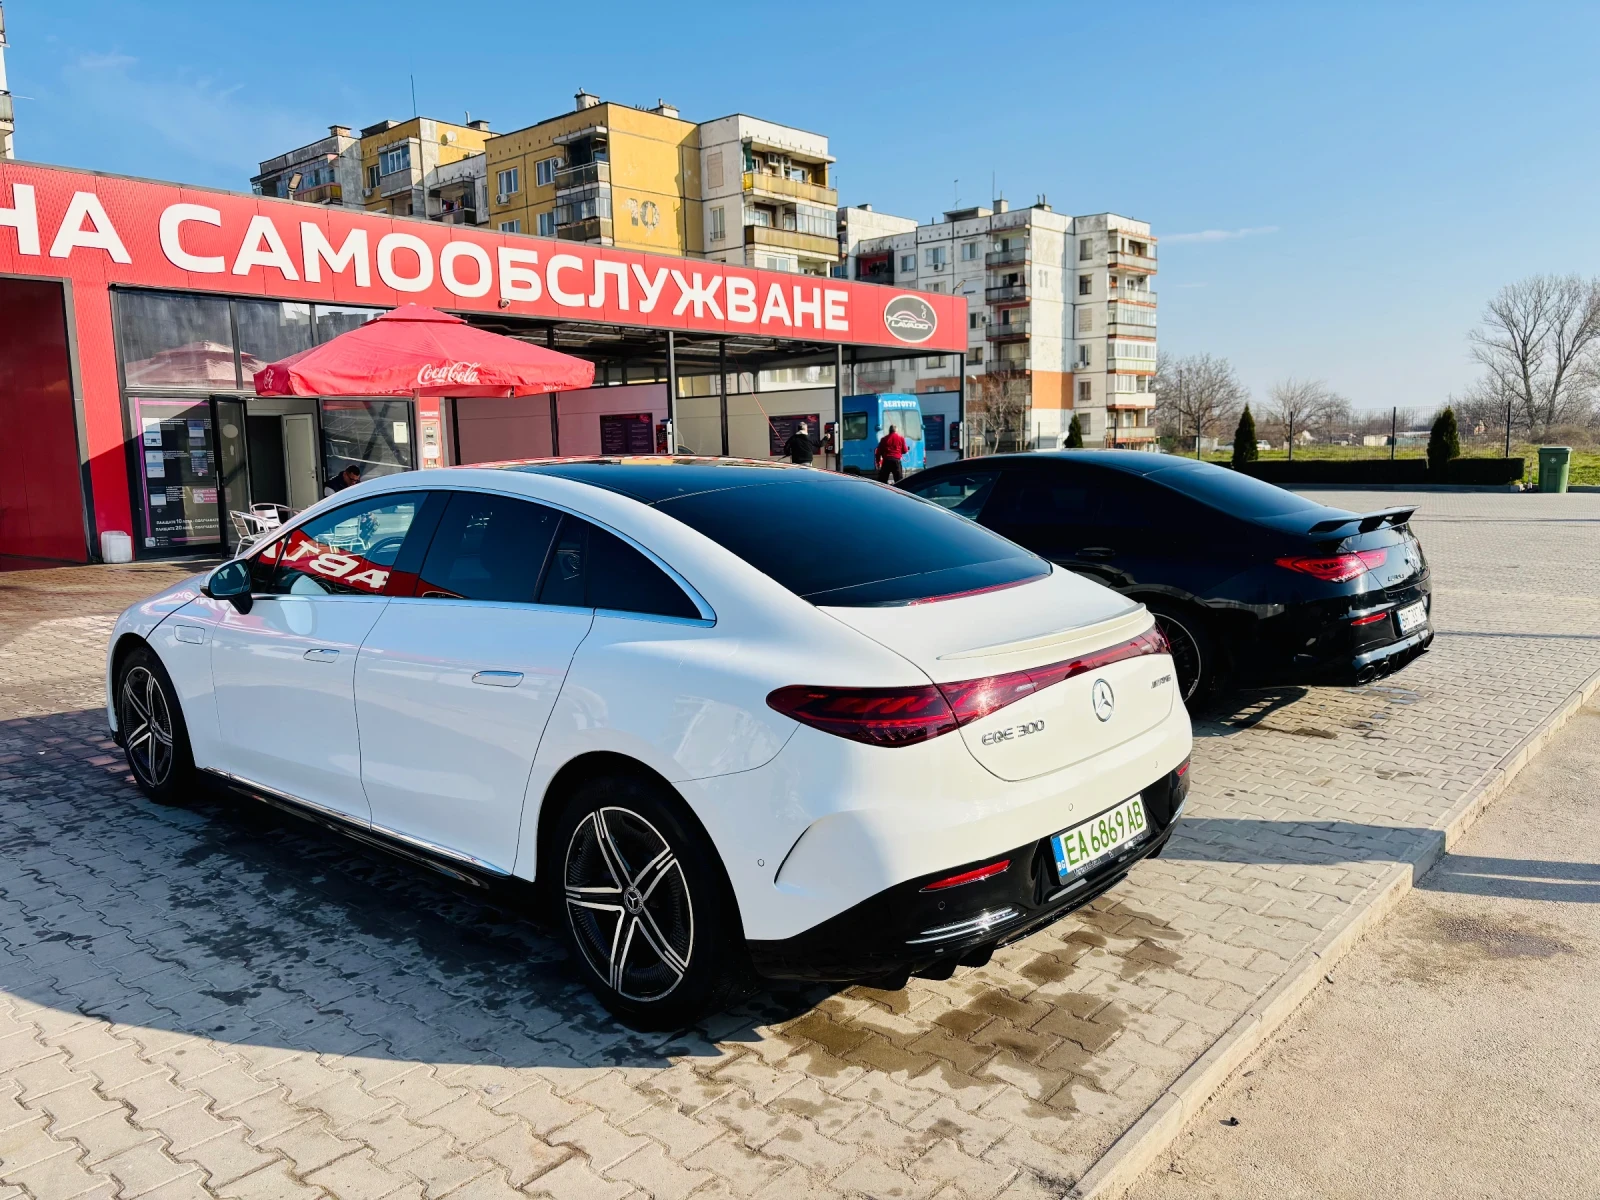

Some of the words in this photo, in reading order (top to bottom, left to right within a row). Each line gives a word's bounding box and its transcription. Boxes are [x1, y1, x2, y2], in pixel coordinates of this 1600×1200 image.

[158, 203, 849, 332] САМООБСЛУЖВАНЕ
[417, 361, 481, 385] Coca-Cola
[981, 727, 1014, 746] EQE
[1017, 719, 1045, 738] 300
[1063, 830, 1090, 866] EA
[1090, 810, 1125, 853] 6869
[1126, 800, 1144, 834] AB
